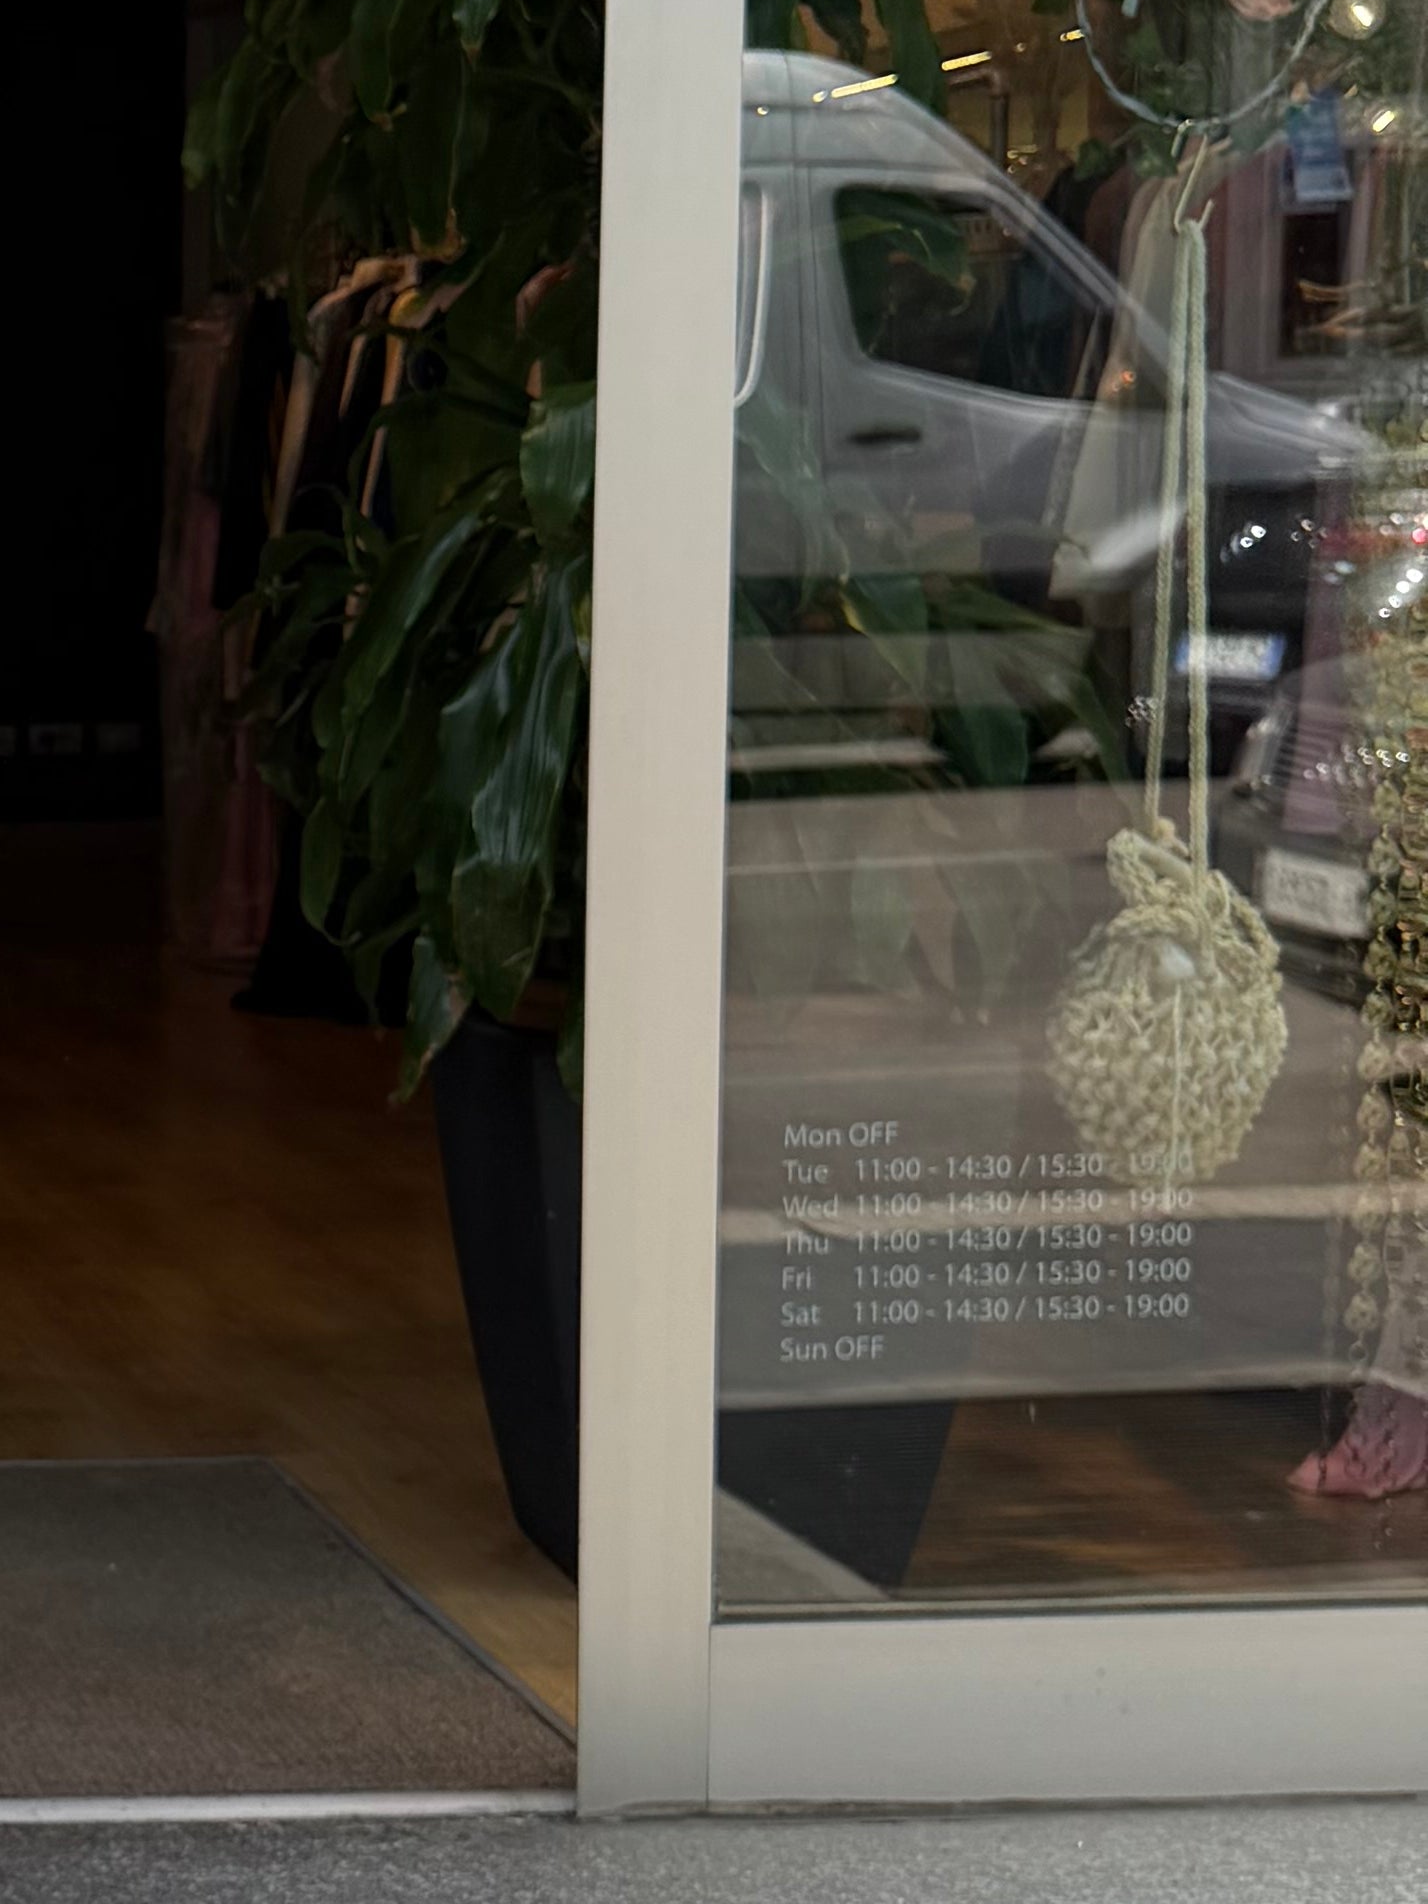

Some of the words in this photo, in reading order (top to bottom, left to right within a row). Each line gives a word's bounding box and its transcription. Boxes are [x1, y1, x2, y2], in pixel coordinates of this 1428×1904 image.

[783, 1123, 842, 1148] Mon
[849, 1121, 899, 1146] OFF
[782, 1159, 829, 1184] Tue
[855, 1157, 921, 1182] 11:00
[946, 1154, 1011, 1181] 14:30
[1039, 1153, 1104, 1178] 15:30
[782, 1193, 839, 1219] Wed
[857, 1193, 922, 1217] 11:00
[948, 1190, 1012, 1215] 14:30
[1039, 1188, 1104, 1214] 15:30
[1129, 1187, 1194, 1213] 19:00
[782, 1228, 829, 1255] Thu
[856, 1228, 921, 1254] 11:00
[946, 1226, 1011, 1252] 14:30
[1037, 1224, 1102, 1249] 15:30
[1128, 1222, 1192, 1247] 19:00
[781, 1264, 812, 1291] Fri
[854, 1264, 920, 1289] 11:00
[945, 1261, 1010, 1287] 14:30
[1036, 1259, 1101, 1284] 15:30
[1126, 1257, 1191, 1282] 19:00
[780, 1300, 821, 1327] Sat
[854, 1300, 920, 1325] 11:00
[944, 1297, 1009, 1323] 14:30
[1036, 1295, 1100, 1321] 15:30
[1125, 1293, 1189, 1318] 19:00
[780, 1337, 828, 1362] Sun
[835, 1334, 885, 1360] OFF
